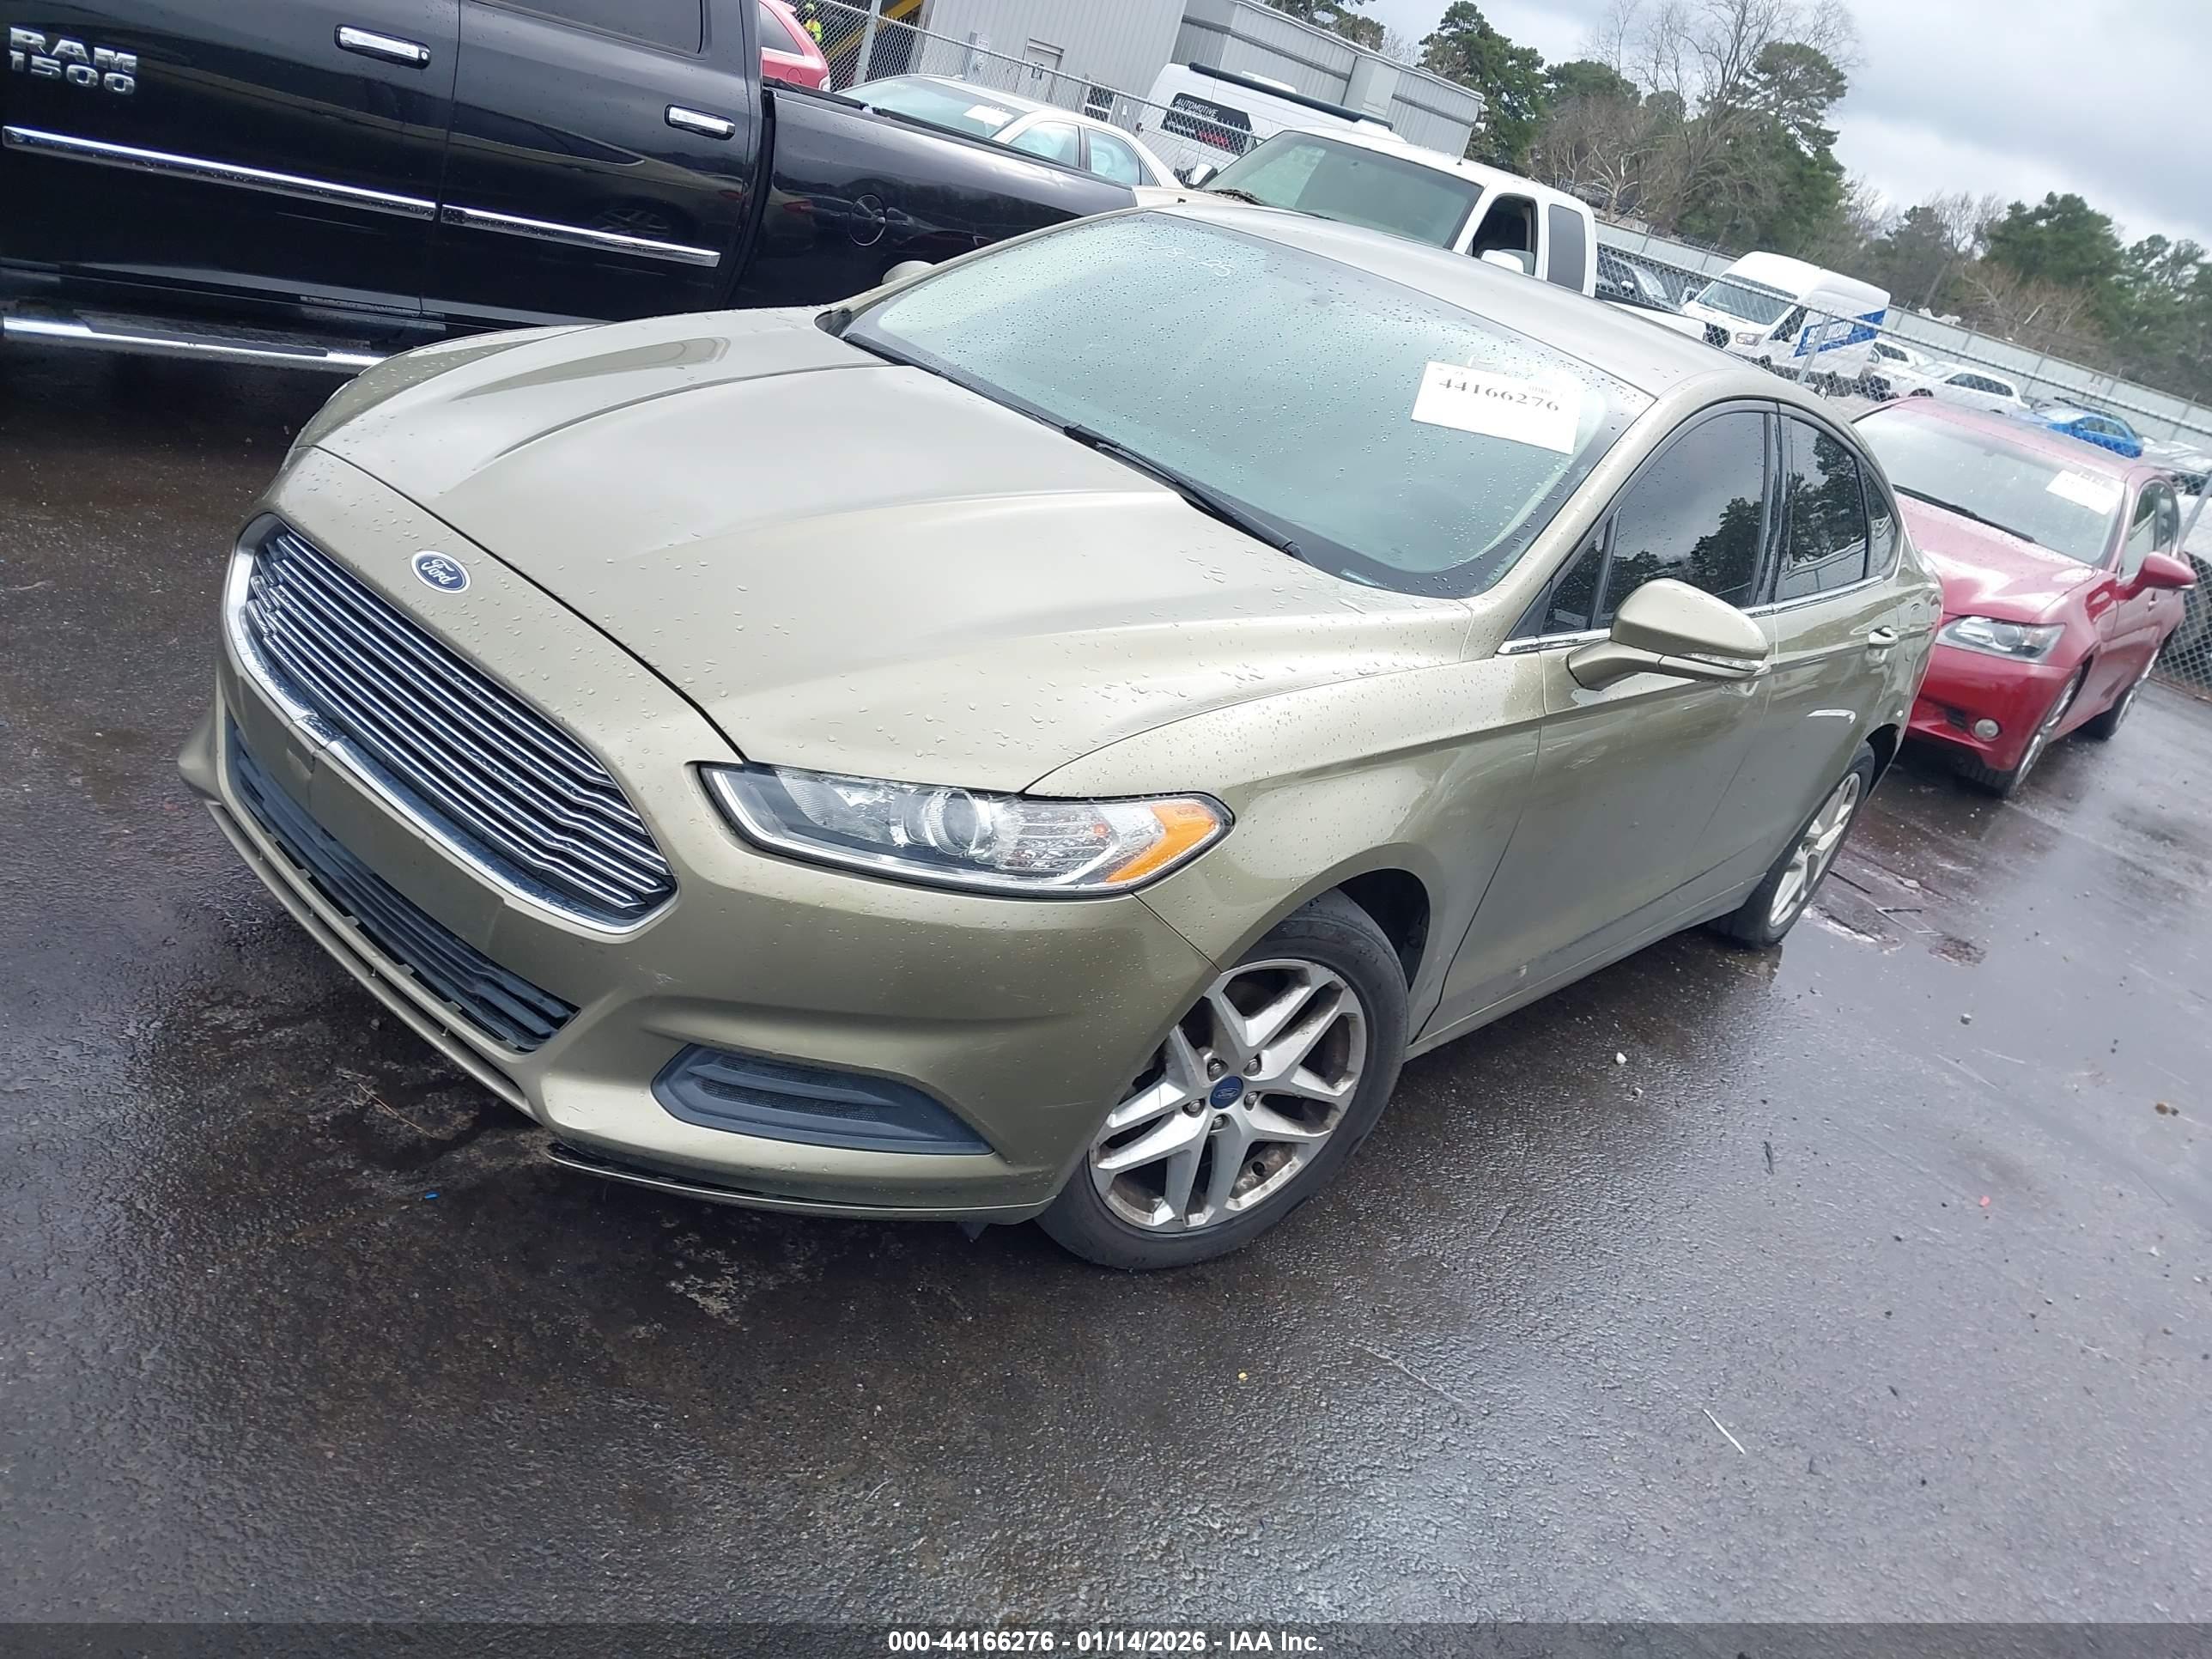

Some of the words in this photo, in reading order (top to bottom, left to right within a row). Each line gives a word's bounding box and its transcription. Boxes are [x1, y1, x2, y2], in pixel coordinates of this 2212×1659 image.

[10, 27, 137, 73] RAM
[9, 49, 135, 95] 1500
[1176, 98, 1218, 117] AUTOMOTIVE
[1438, 378, 1559, 411] 44166276
[421, 558, 458, 584] Ford
